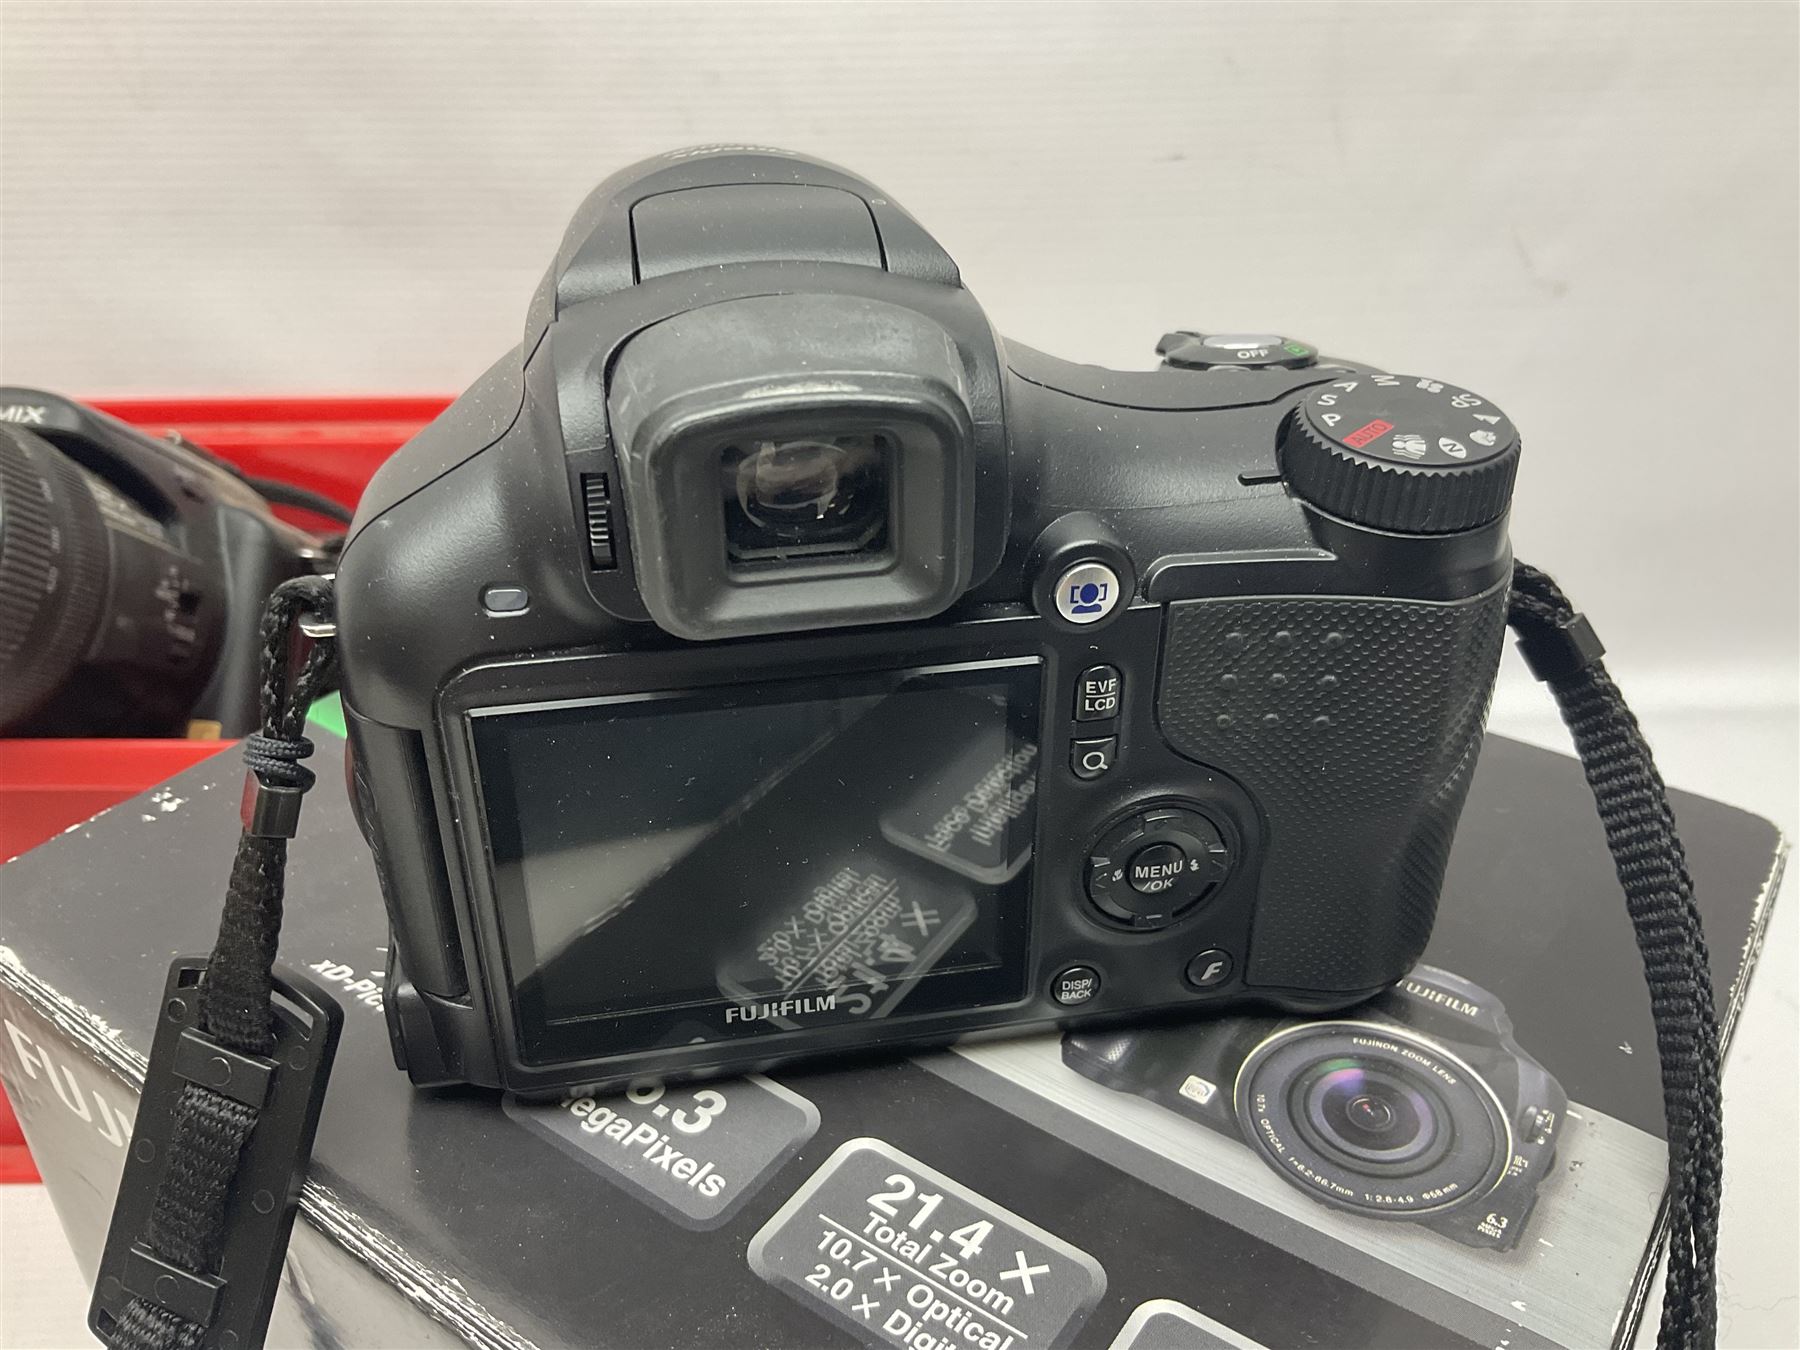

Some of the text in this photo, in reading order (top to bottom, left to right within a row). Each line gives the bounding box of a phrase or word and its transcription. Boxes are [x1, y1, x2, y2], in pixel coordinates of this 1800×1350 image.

[1237, 349, 1269, 359] OFF
[1333, 381, 1358, 392] A
[1317, 394, 1338, 406] S
[1321, 413, 1342, 426] P
[1086, 678, 1117, 694] EVF
[1085, 696, 1116, 711] LCD
[1135, 860, 1183, 879] MENU
[309, 959, 385, 1012] xD-Pic
[1061, 988, 1092, 1000] BACK
[1062, 978, 1092, 991] DISP/
[726, 995, 836, 1023] FUJIFILM
[1352, 1037, 1457, 1085] FUJINON ZOOM LENS
[561, 1096, 727, 1197] egaPixels
[1260, 1118, 1286, 1154] OPTICAL
[866, 1173, 994, 1260] 21.4
[863, 1211, 1015, 1315] Total Zoom
[804, 1263, 854, 1300] 2.0
[817, 1230, 878, 1272] 10.7
[906, 1284, 1015, 1350] Optical
